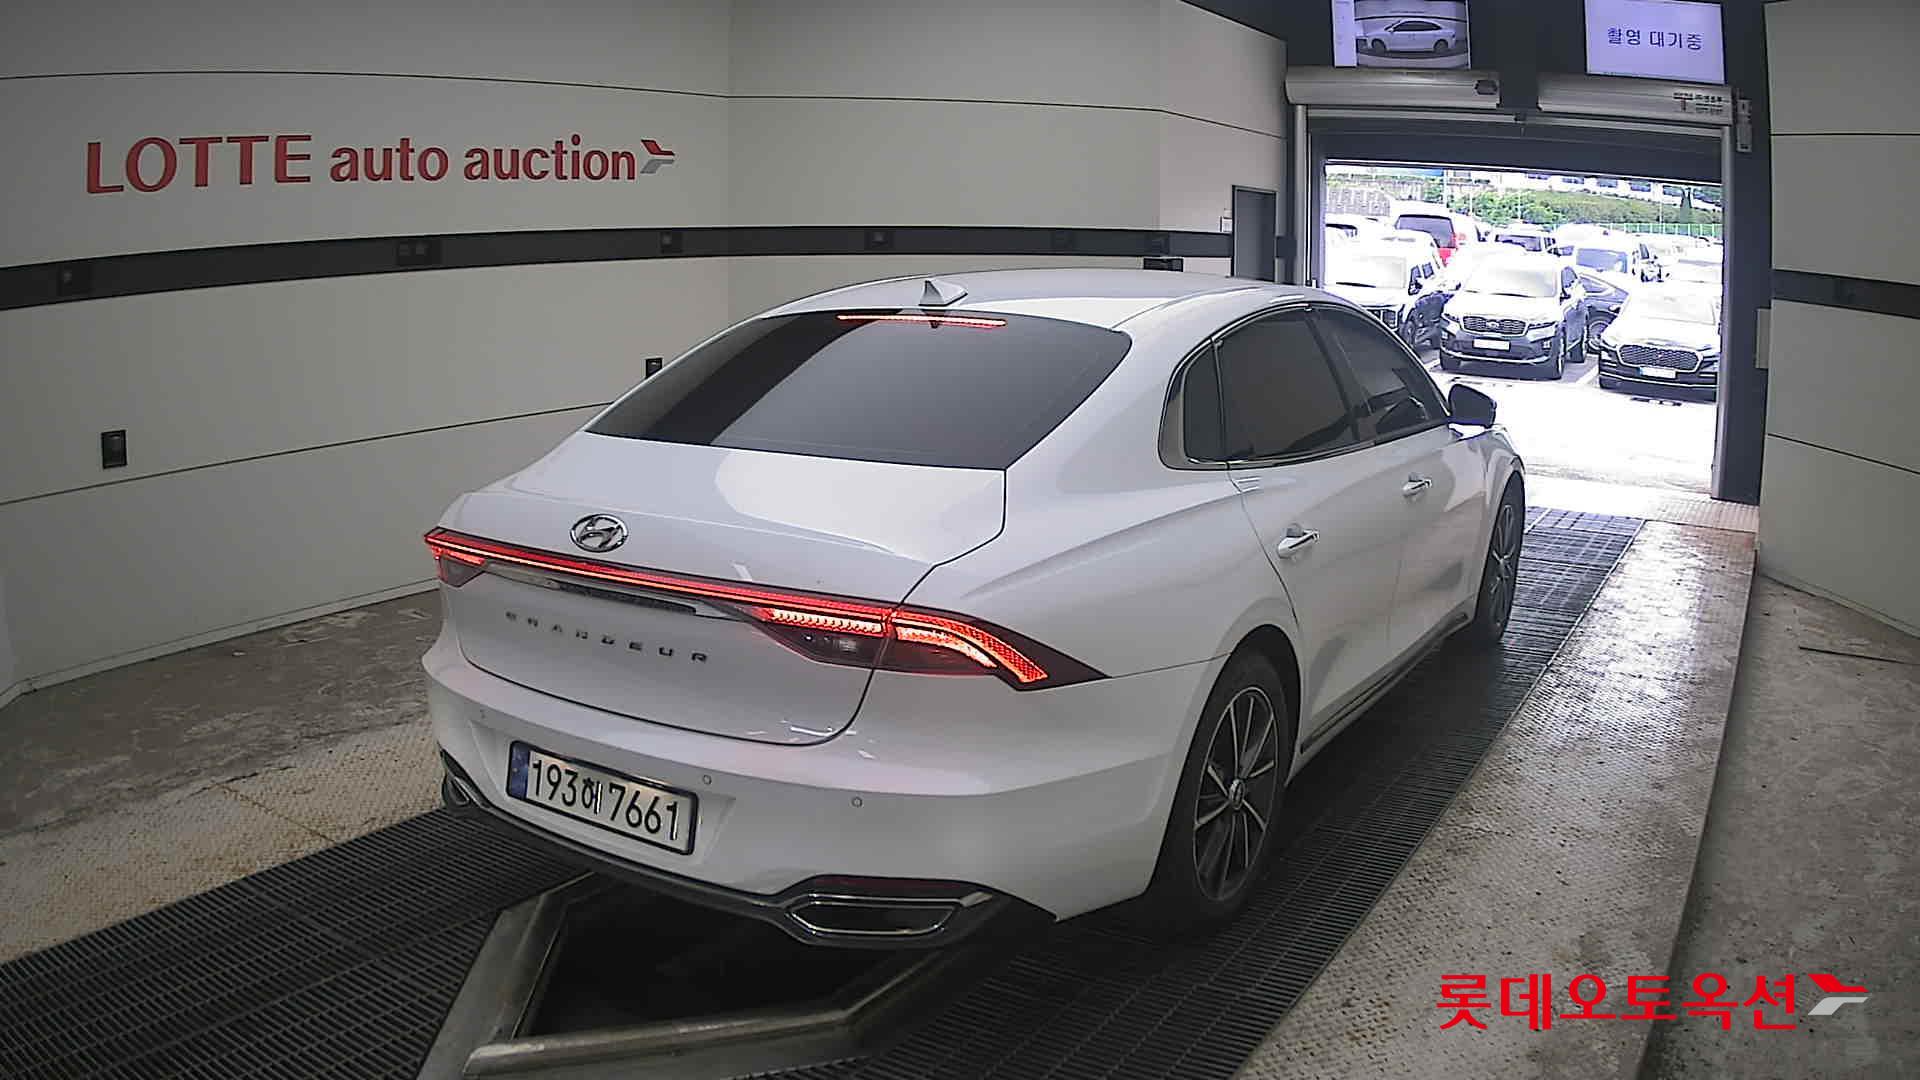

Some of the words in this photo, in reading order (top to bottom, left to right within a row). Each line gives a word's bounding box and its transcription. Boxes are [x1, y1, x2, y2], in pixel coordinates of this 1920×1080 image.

[1649, 31, 1702, 51] 대기중
[87, 134, 312, 194] LOTTE
[329, 137, 450, 183] auto
[463, 134, 637, 181] auction
